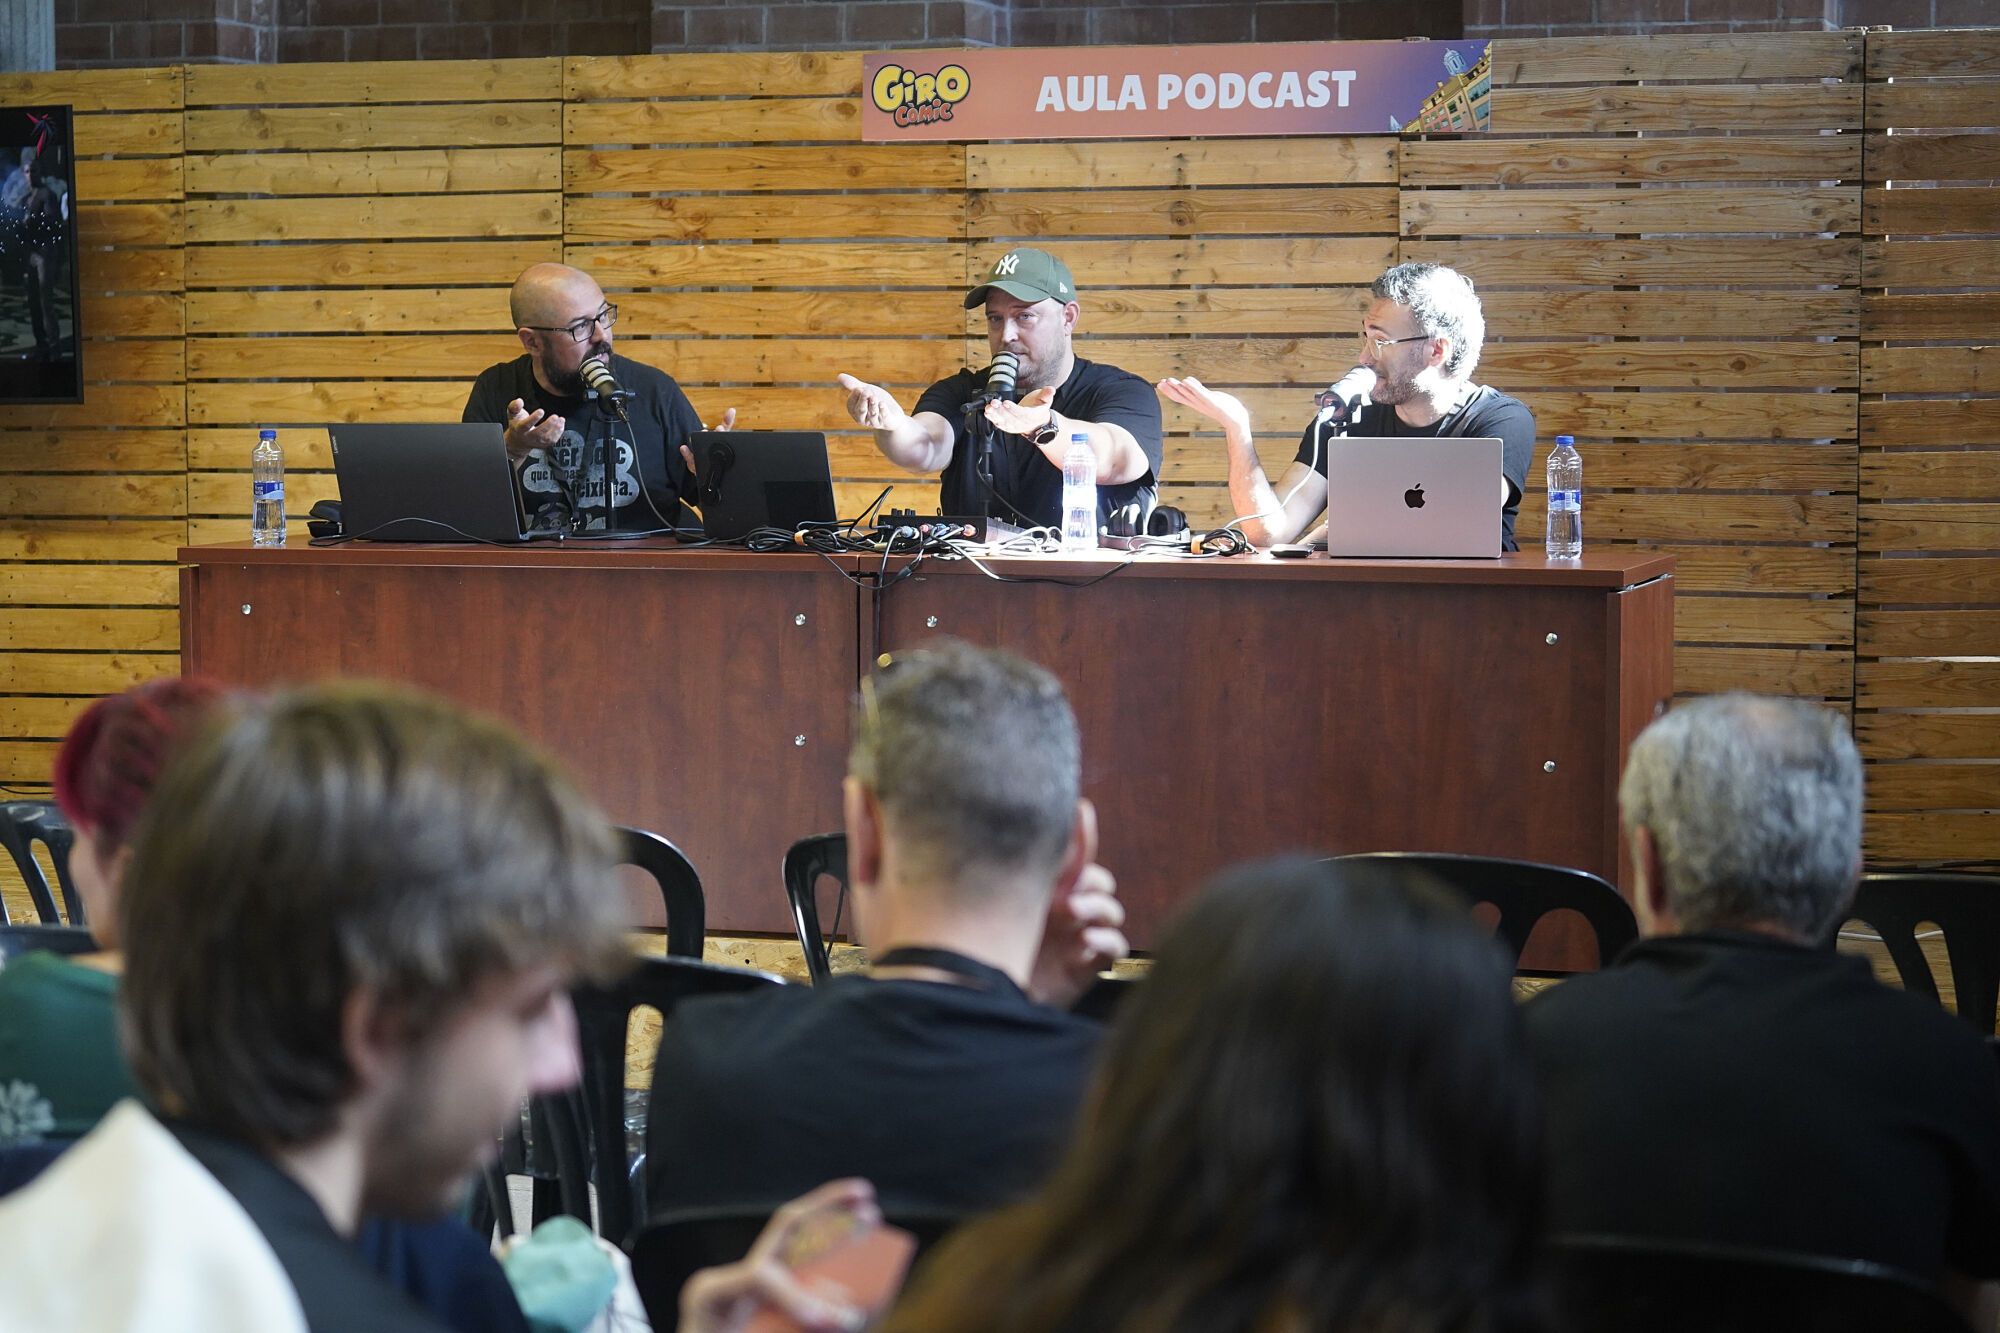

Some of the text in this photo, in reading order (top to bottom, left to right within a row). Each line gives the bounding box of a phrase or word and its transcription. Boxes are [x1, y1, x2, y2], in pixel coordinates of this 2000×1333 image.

[1035, 70, 1357, 112] AULA PODCAST
[995, 254, 1019, 275] NY
[554, 447, 579, 468] er
[531, 470, 548, 484] que
